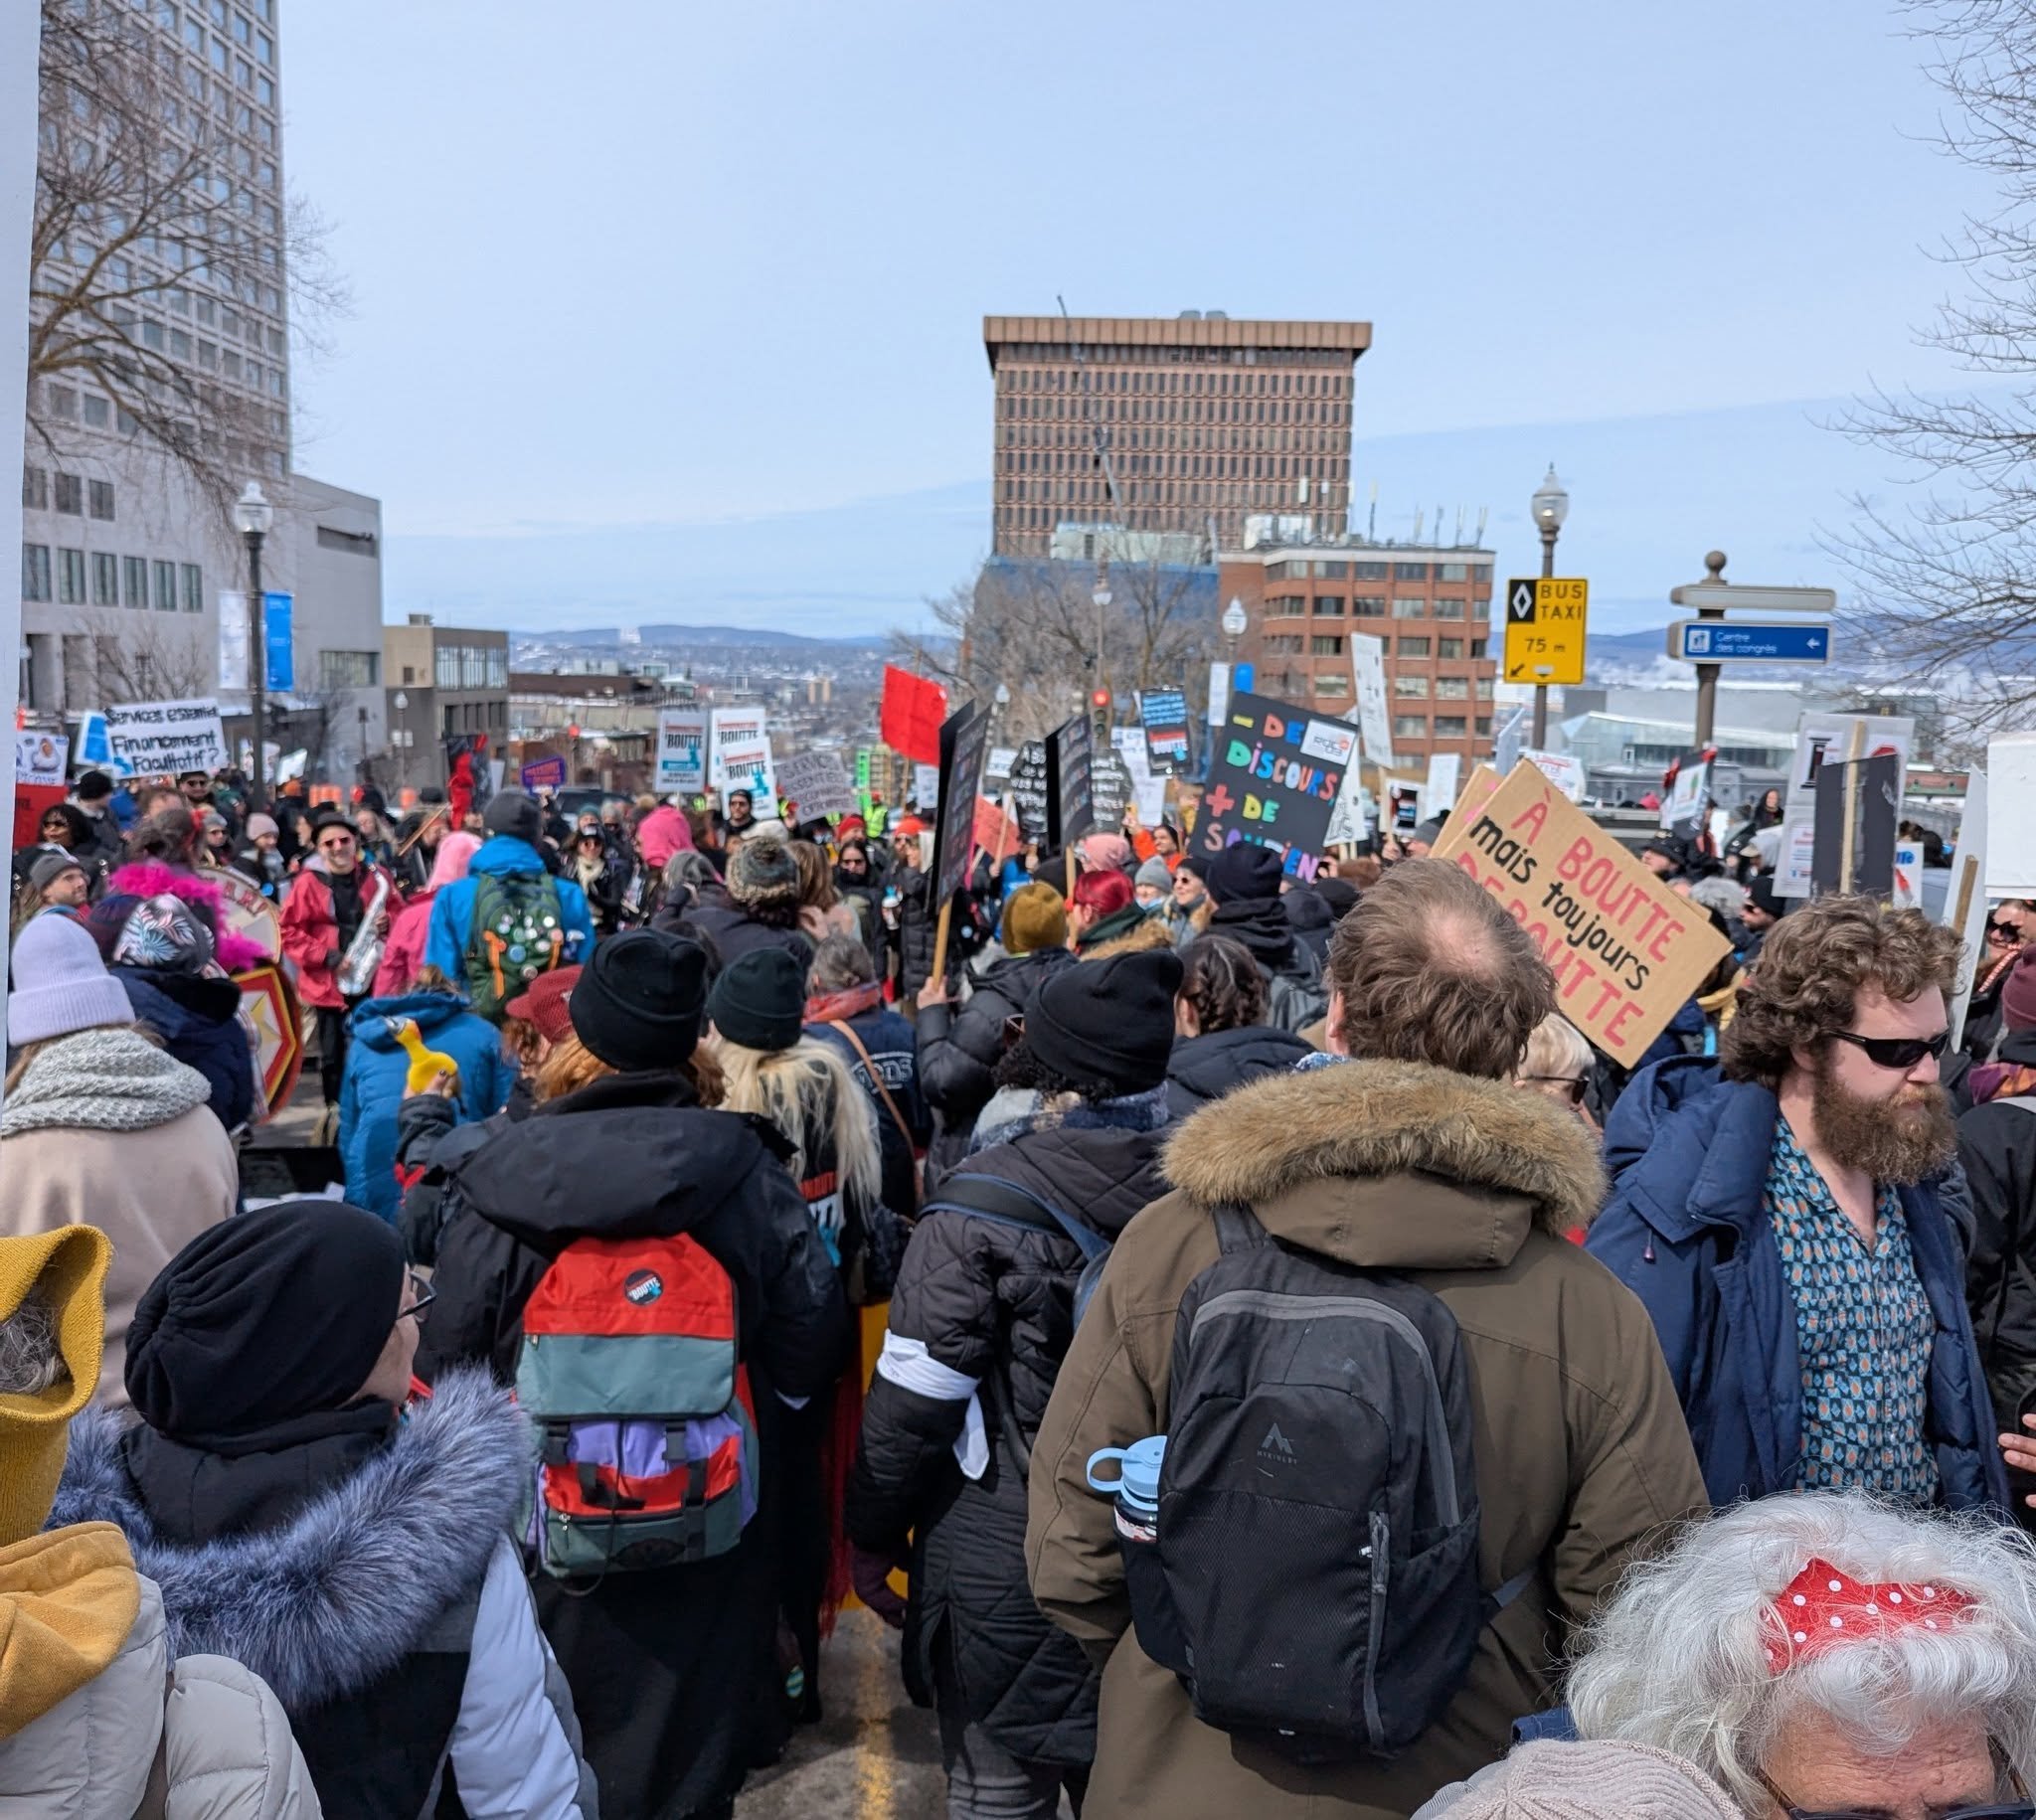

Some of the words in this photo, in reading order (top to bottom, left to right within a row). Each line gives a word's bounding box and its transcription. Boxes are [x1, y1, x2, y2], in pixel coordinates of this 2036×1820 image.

[1540, 584, 1583, 599] BUS
[1540, 604, 1583, 620] TAXI
[1525, 637, 1547, 653] 75
[1554, 643, 1566, 653] m
[1715, 631, 1751, 643] Centre
[1715, 643, 1734, 653] des
[1737, 643, 1778, 656] congrès
[1264, 713, 1304, 745] DE
[1243, 793, 1280, 823] DE
[1511, 786, 1551, 845] À
[1556, 836, 1686, 963] BOUTTE
[1469, 815, 1538, 885] mais
[1541, 881, 1649, 991] toujours
